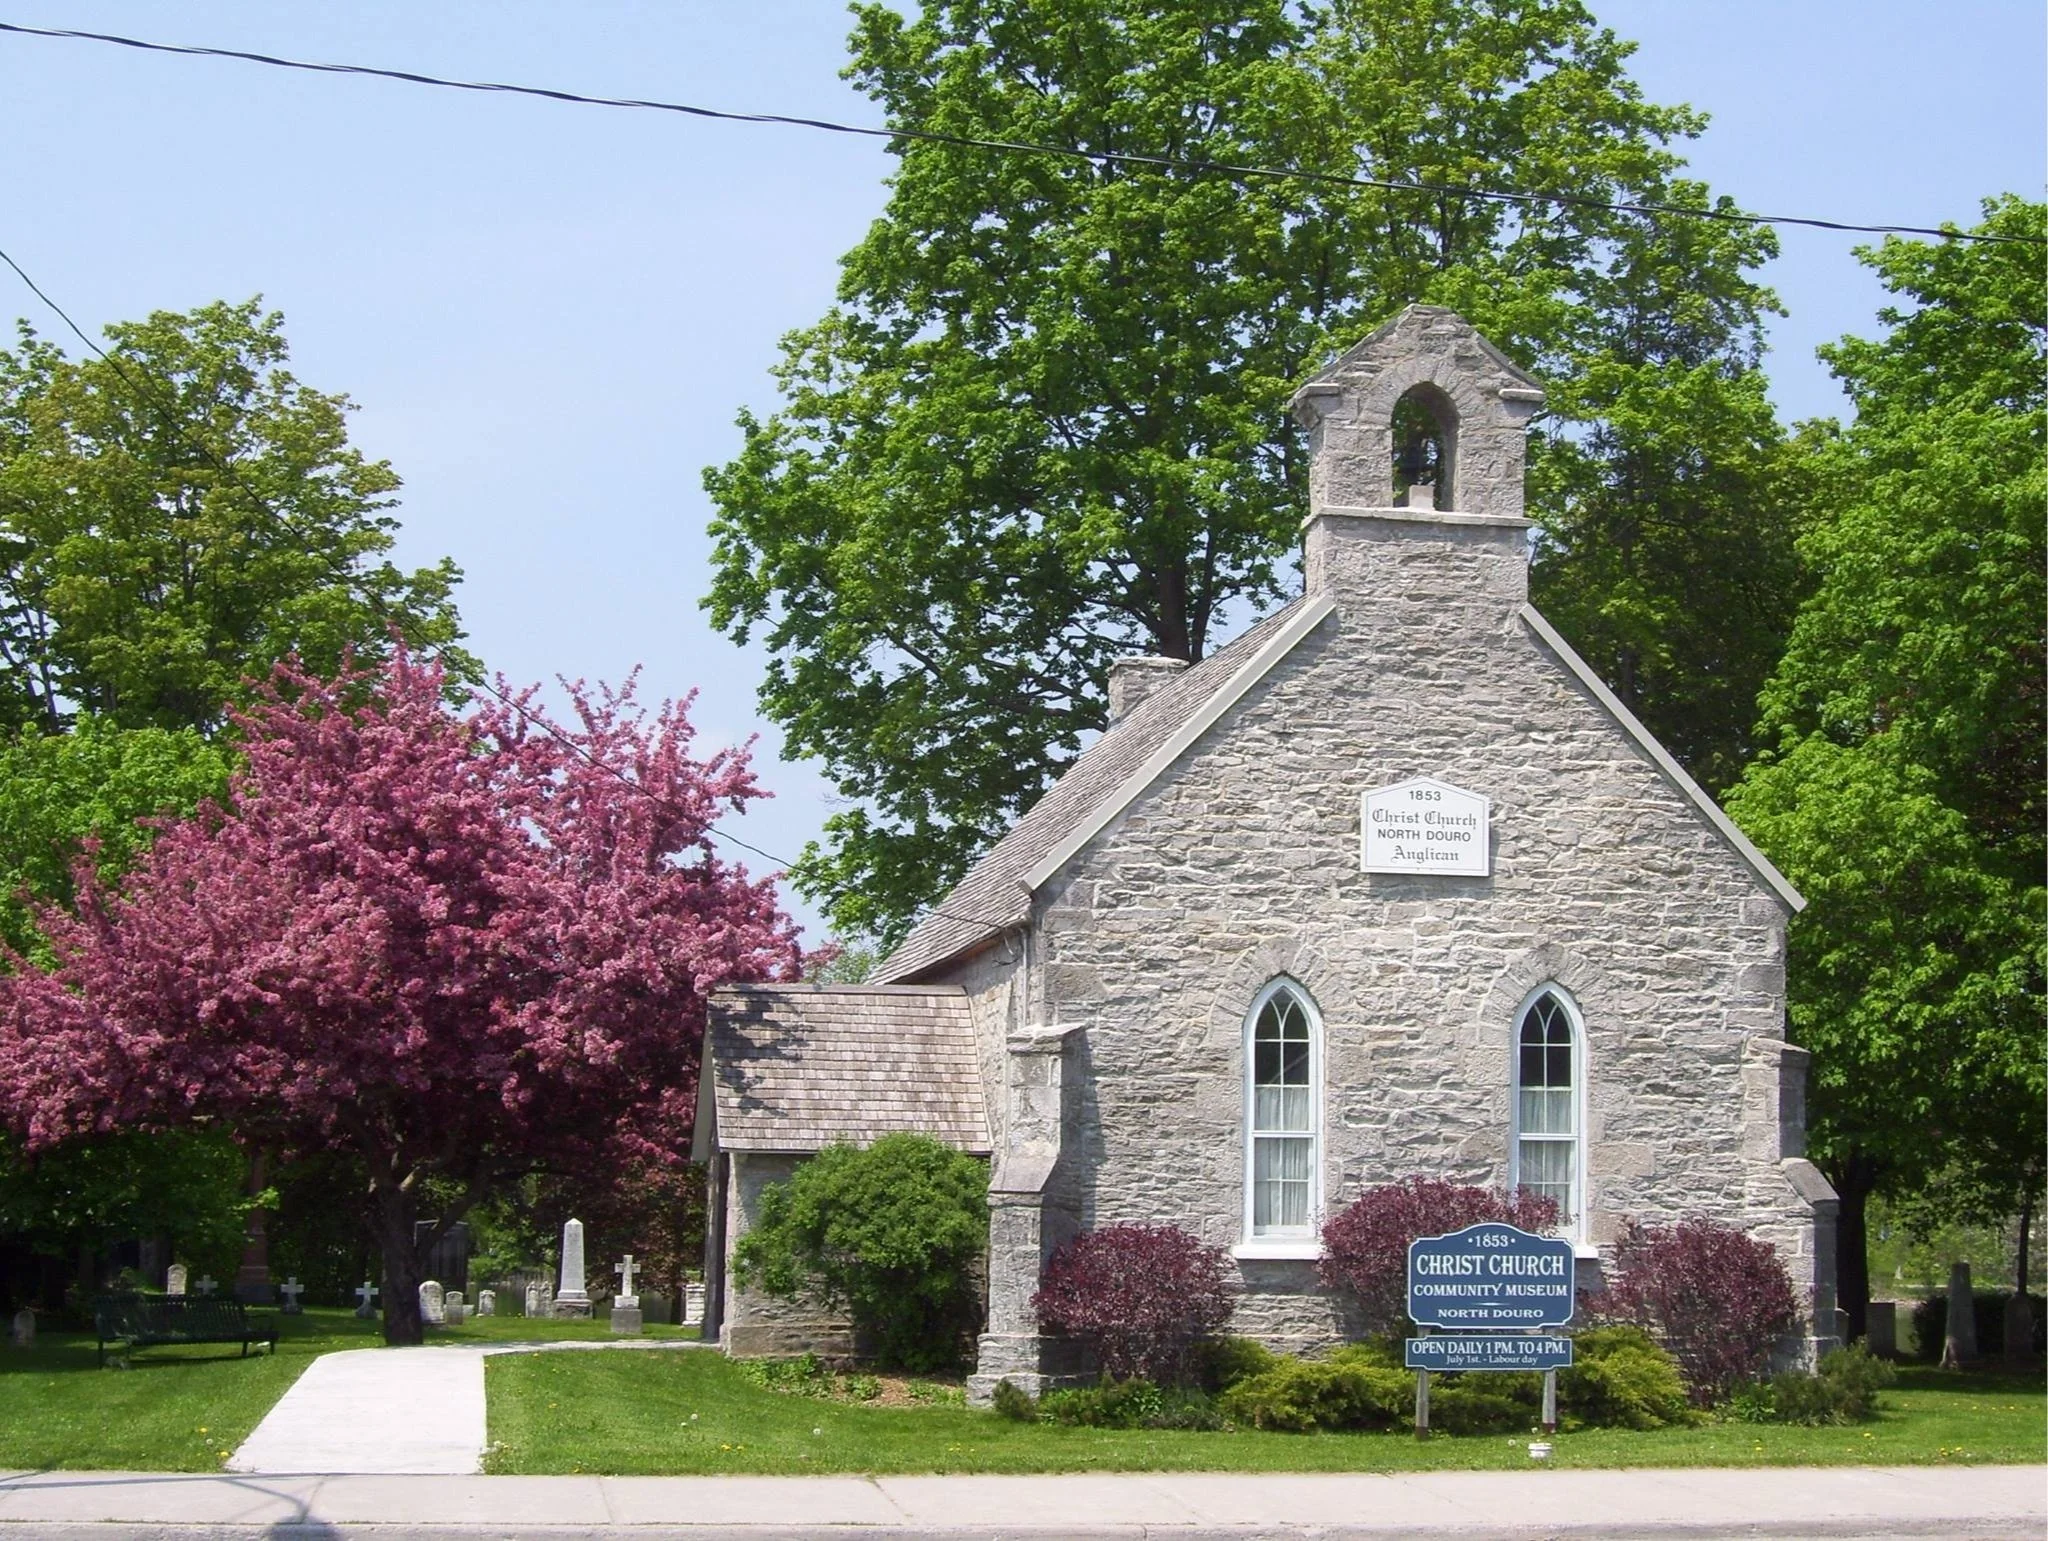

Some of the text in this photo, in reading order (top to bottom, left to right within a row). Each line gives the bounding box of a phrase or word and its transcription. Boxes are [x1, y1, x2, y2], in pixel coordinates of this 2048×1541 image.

[1409, 790, 1442, 801] 1853
[1372, 808, 1477, 830] Christ Church
[1377, 829, 1471, 842] NORTH DOURO
[1391, 845, 1459, 864] Anglican
[1475, 1233, 1509, 1248] 1853
[1416, 1254, 1565, 1277] CHRIST CHURCH
[1413, 1282, 1568, 1297] COMMUNITY MUSEUM
[1438, 1309, 1544, 1318] NORTH DOURO
[1412, 1341, 1445, 1354] OPEN
[1447, 1341, 1485, 1354] DAILY
[1485, 1341, 1492, 1354] 1
[1517, 1341, 1535, 1354] TO
[1536, 1342, 1543, 1354] 4
[1446, 1355, 1465, 1366] July
[1488, 1354, 1520, 1364] Labour
[1521, 1354, 1538, 1366] day
